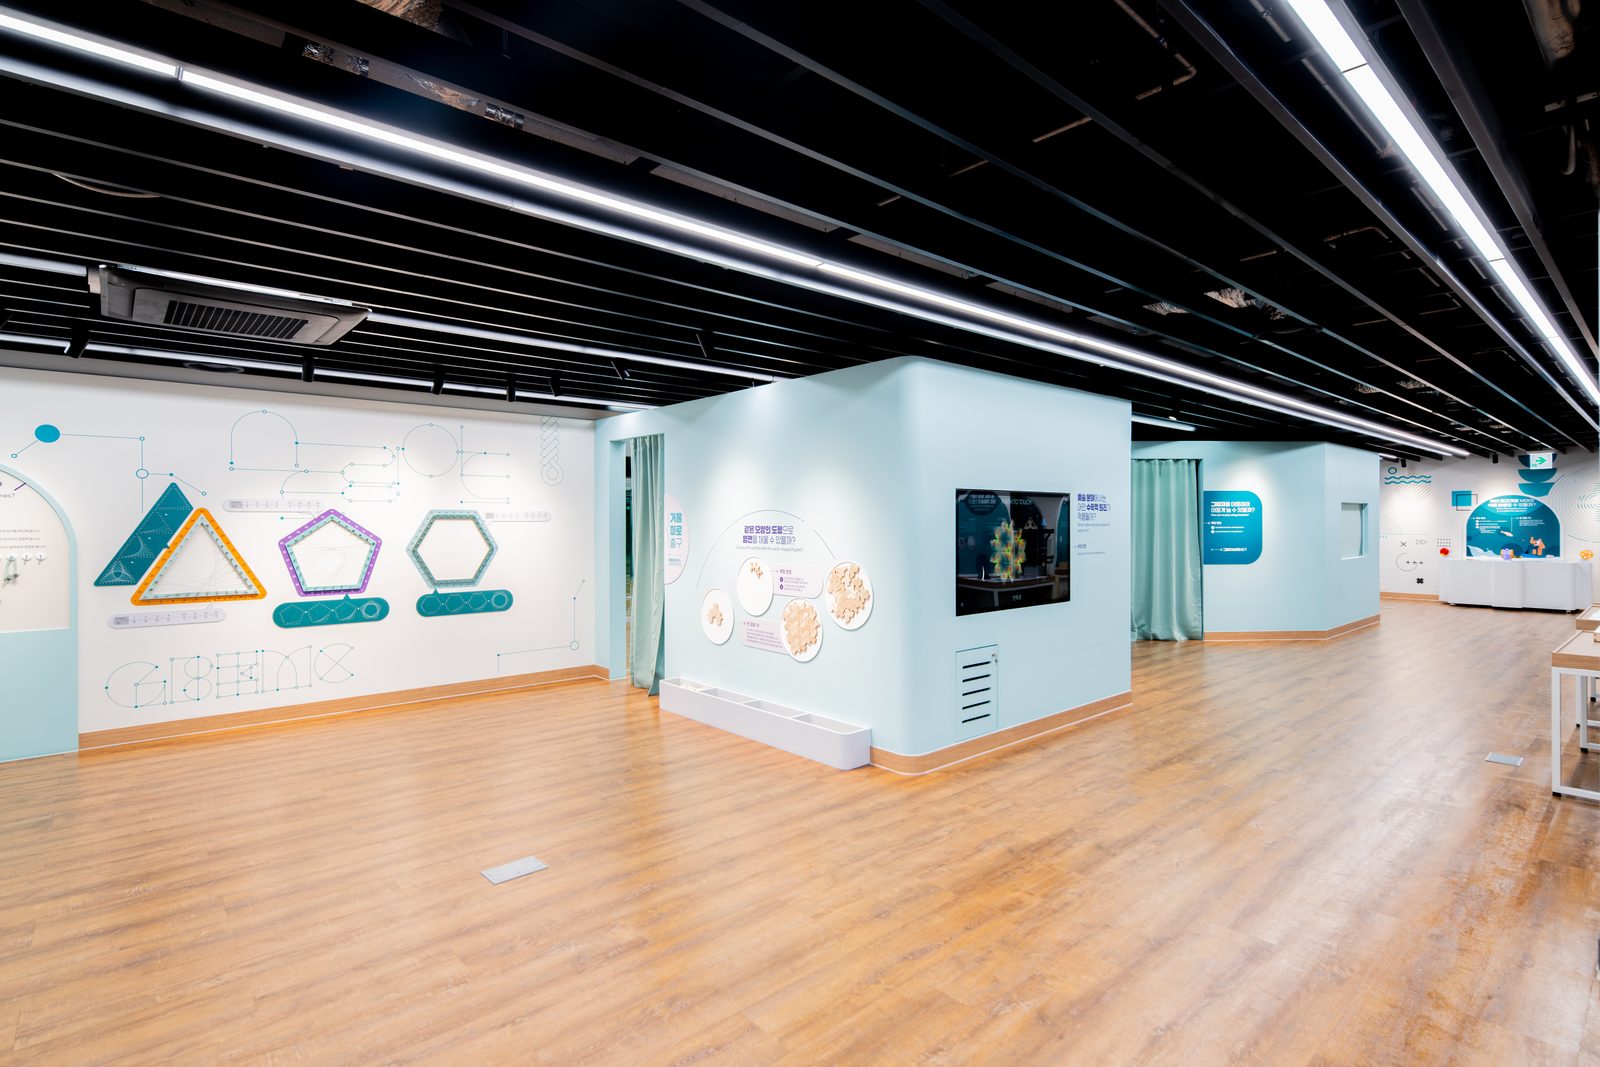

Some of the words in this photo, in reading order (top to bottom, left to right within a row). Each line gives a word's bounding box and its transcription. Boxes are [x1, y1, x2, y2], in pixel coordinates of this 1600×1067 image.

[755, 525, 771, 534] 모양의
[771, 525, 794, 535] 도형으로
[769, 536, 775, 544] 수
